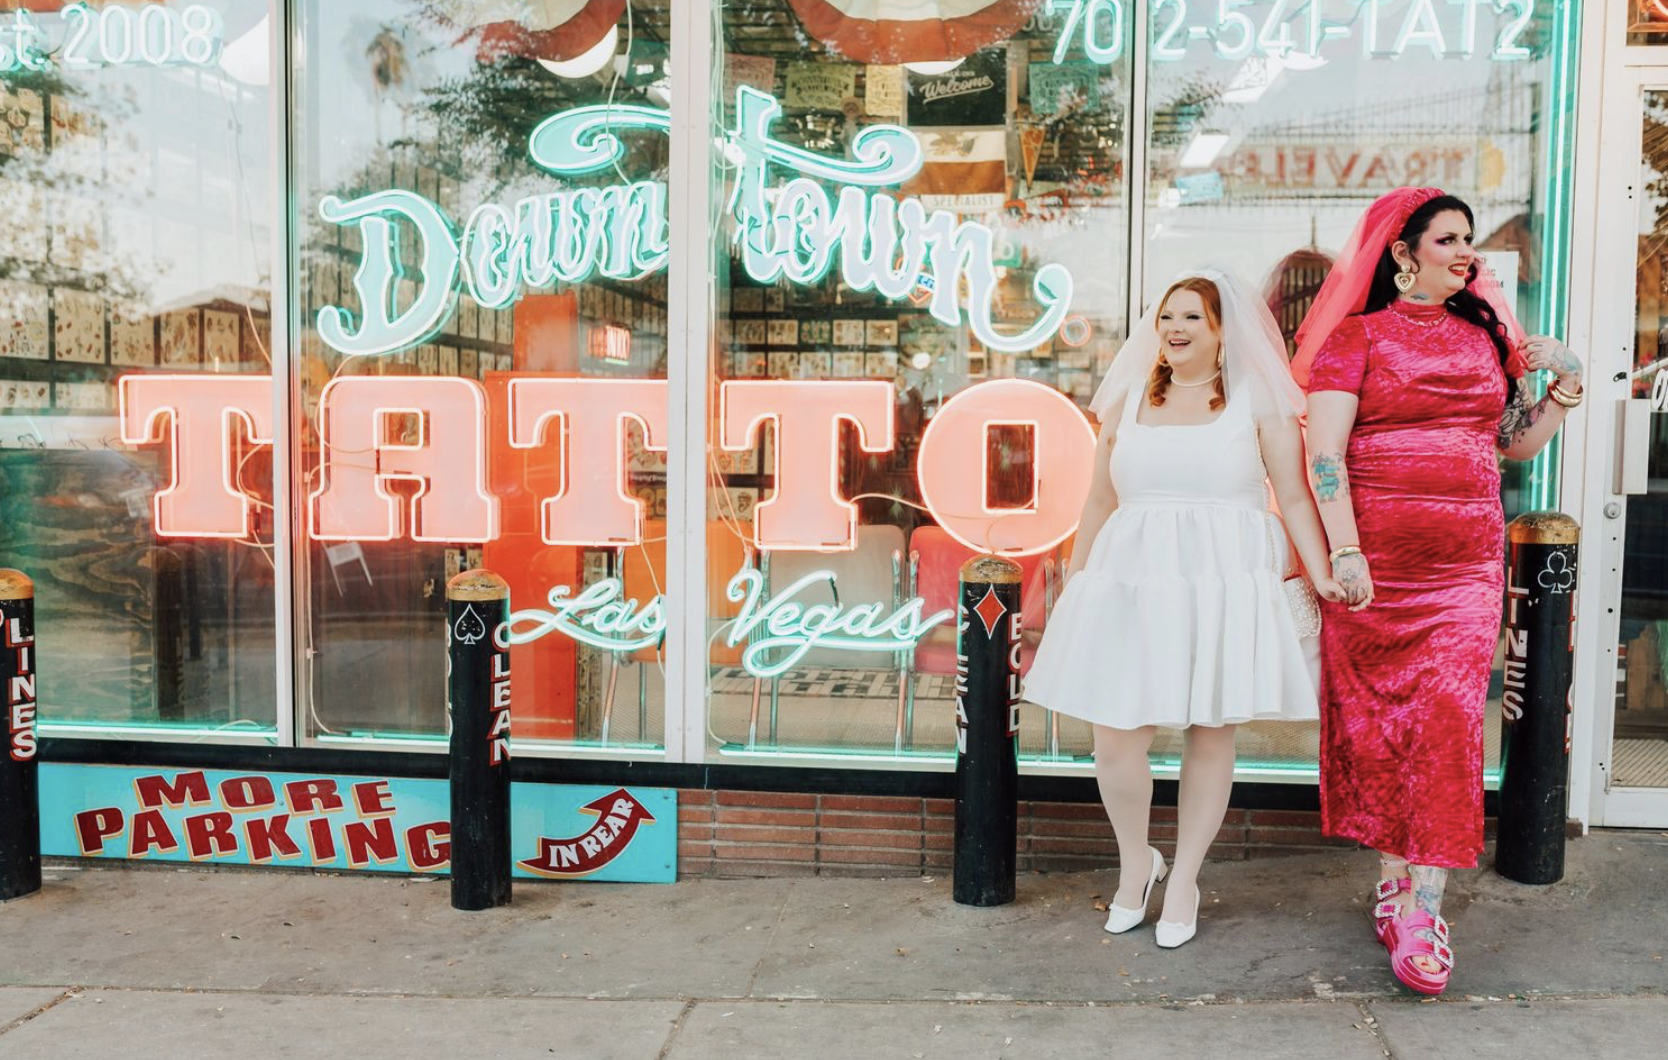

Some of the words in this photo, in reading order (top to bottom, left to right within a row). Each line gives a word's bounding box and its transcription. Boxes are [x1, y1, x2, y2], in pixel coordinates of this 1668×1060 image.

[60, 4, 222, 67] 2008
[919, 75, 994, 104] Welcome
[508, 576, 667, 652] Las
[726, 568, 956, 678] Vegas
[1502, 566, 1529, 721] LINES
[6, 616, 38, 762] LINES
[488, 620, 512, 767] CLEAN
[956, 603, 971, 755] CEAN
[133, 769, 397, 817] MORE
[549, 843, 580, 868] IN
[577, 797, 635, 860] REAR
[74, 805, 451, 873] PARKING
